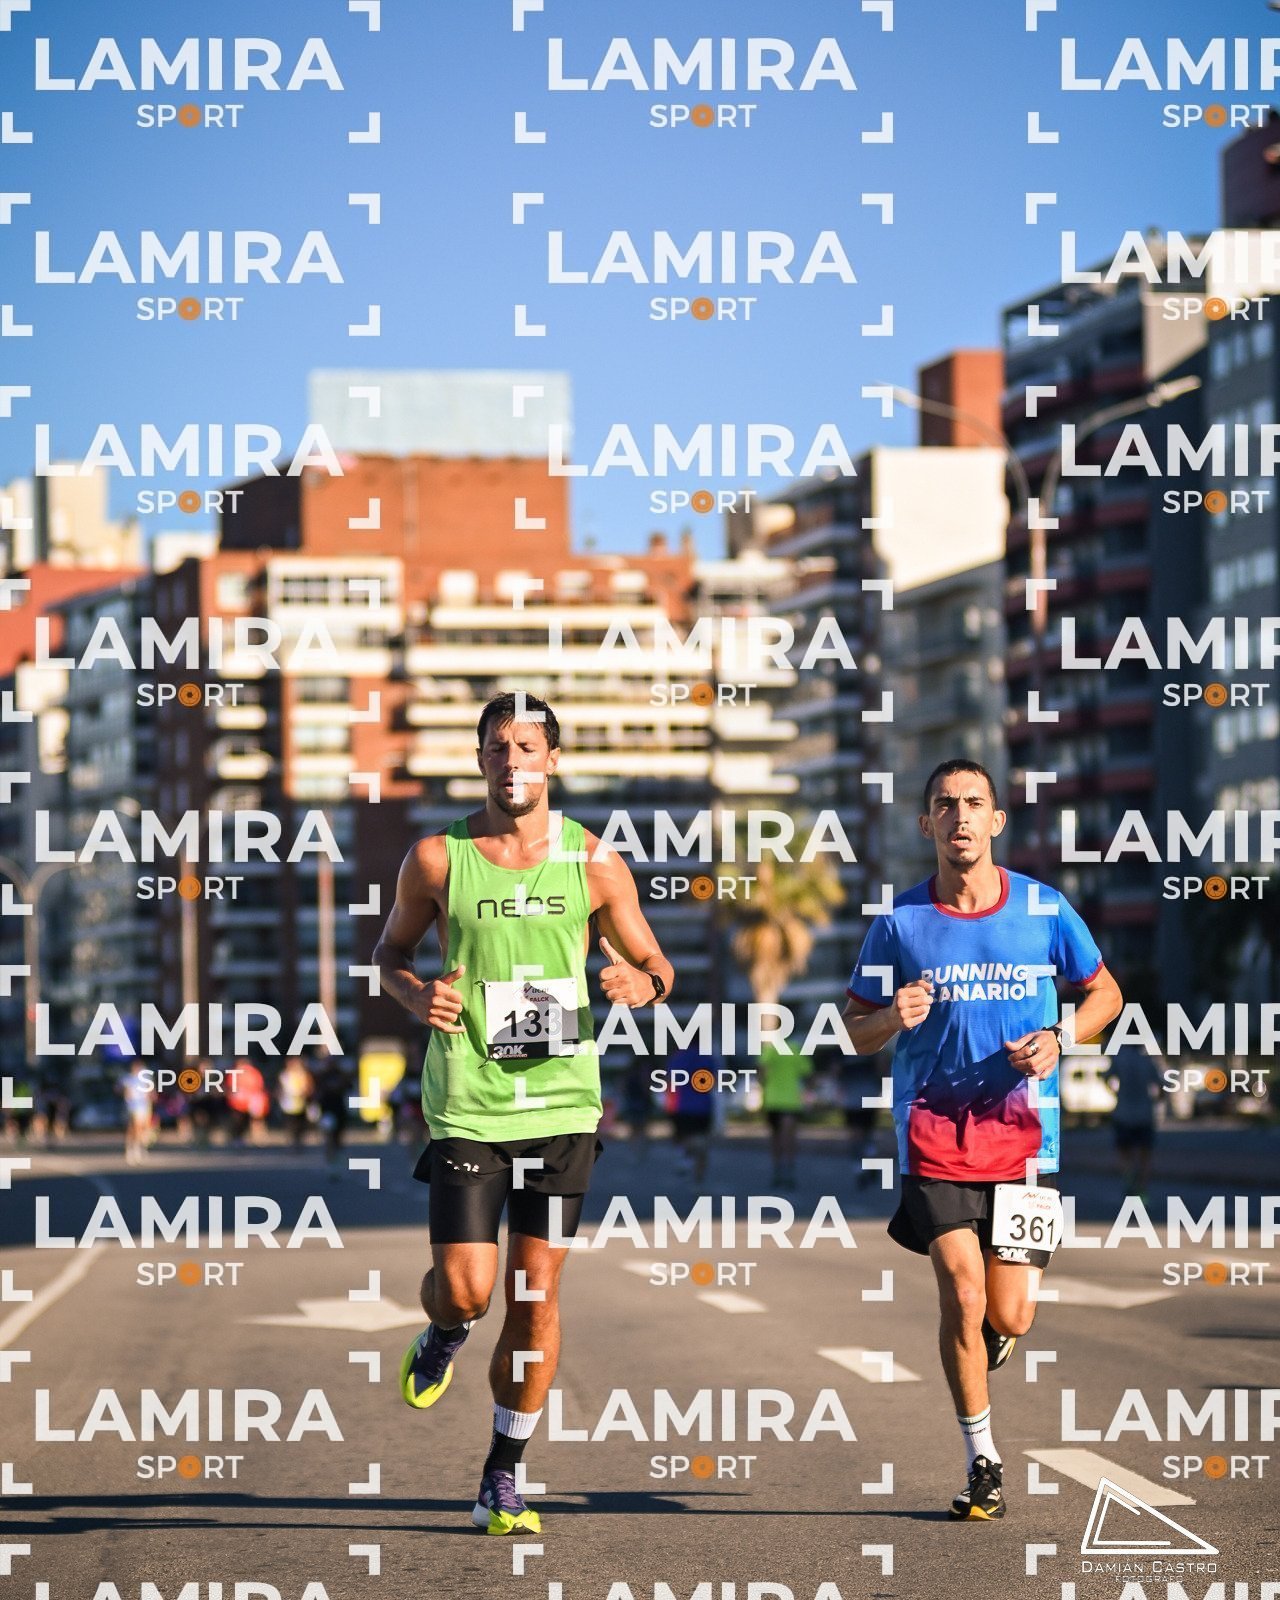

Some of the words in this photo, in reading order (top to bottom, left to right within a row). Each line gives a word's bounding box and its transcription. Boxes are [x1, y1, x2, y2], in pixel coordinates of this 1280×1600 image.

[921, 963, 1029, 985] RUNNING
[931, 983, 1026, 1002] ANARIO
[504, 1008, 562, 1038] 133
[1009, 1213, 1055, 1246] 361
